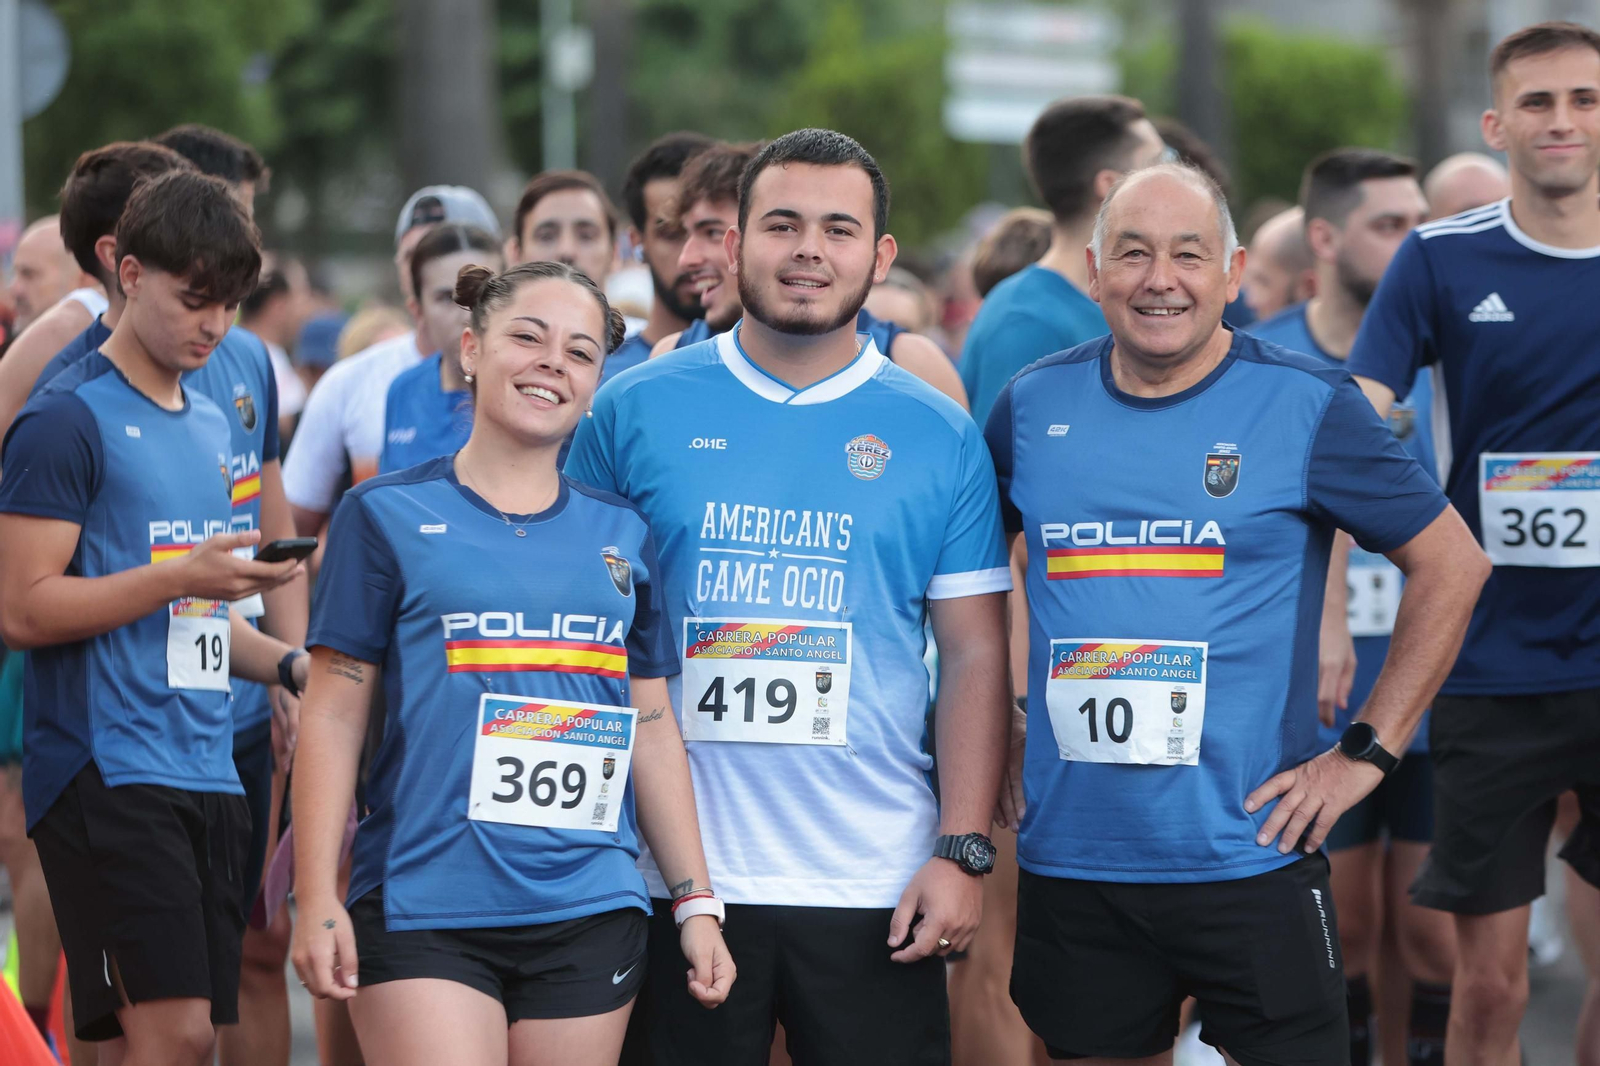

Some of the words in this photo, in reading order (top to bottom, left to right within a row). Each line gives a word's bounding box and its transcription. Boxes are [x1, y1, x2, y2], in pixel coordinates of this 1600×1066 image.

[1469, 312, 1514, 322] adidas
[847, 443, 889, 458] XEREZ
[700, 502, 852, 551] AMERICAN'S
[1501, 508, 1587, 548] 362
[696, 560, 771, 604] GAME
[783, 566, 844, 612] OCIO
[697, 631, 763, 643] CARRERA
[768, 633, 836, 647] POPULAR
[765, 648, 803, 657] SANTO
[806, 650, 842, 660] ANGEL
[1059, 651, 1118, 664] CARRERA
[1123, 652, 1192, 666] POPULAR
[1120, 667, 1158, 678] SANTO
[1161, 669, 1197, 679] ANGEL
[698, 676, 797, 724] 419
[495, 708, 562, 726] CARRERA
[566, 716, 623, 733] POPULAR
[1079, 697, 1133, 743] 10
[564, 729, 596, 742] SANTO
[597, 735, 626, 746] ANGEL
[492, 756, 586, 810] 369
